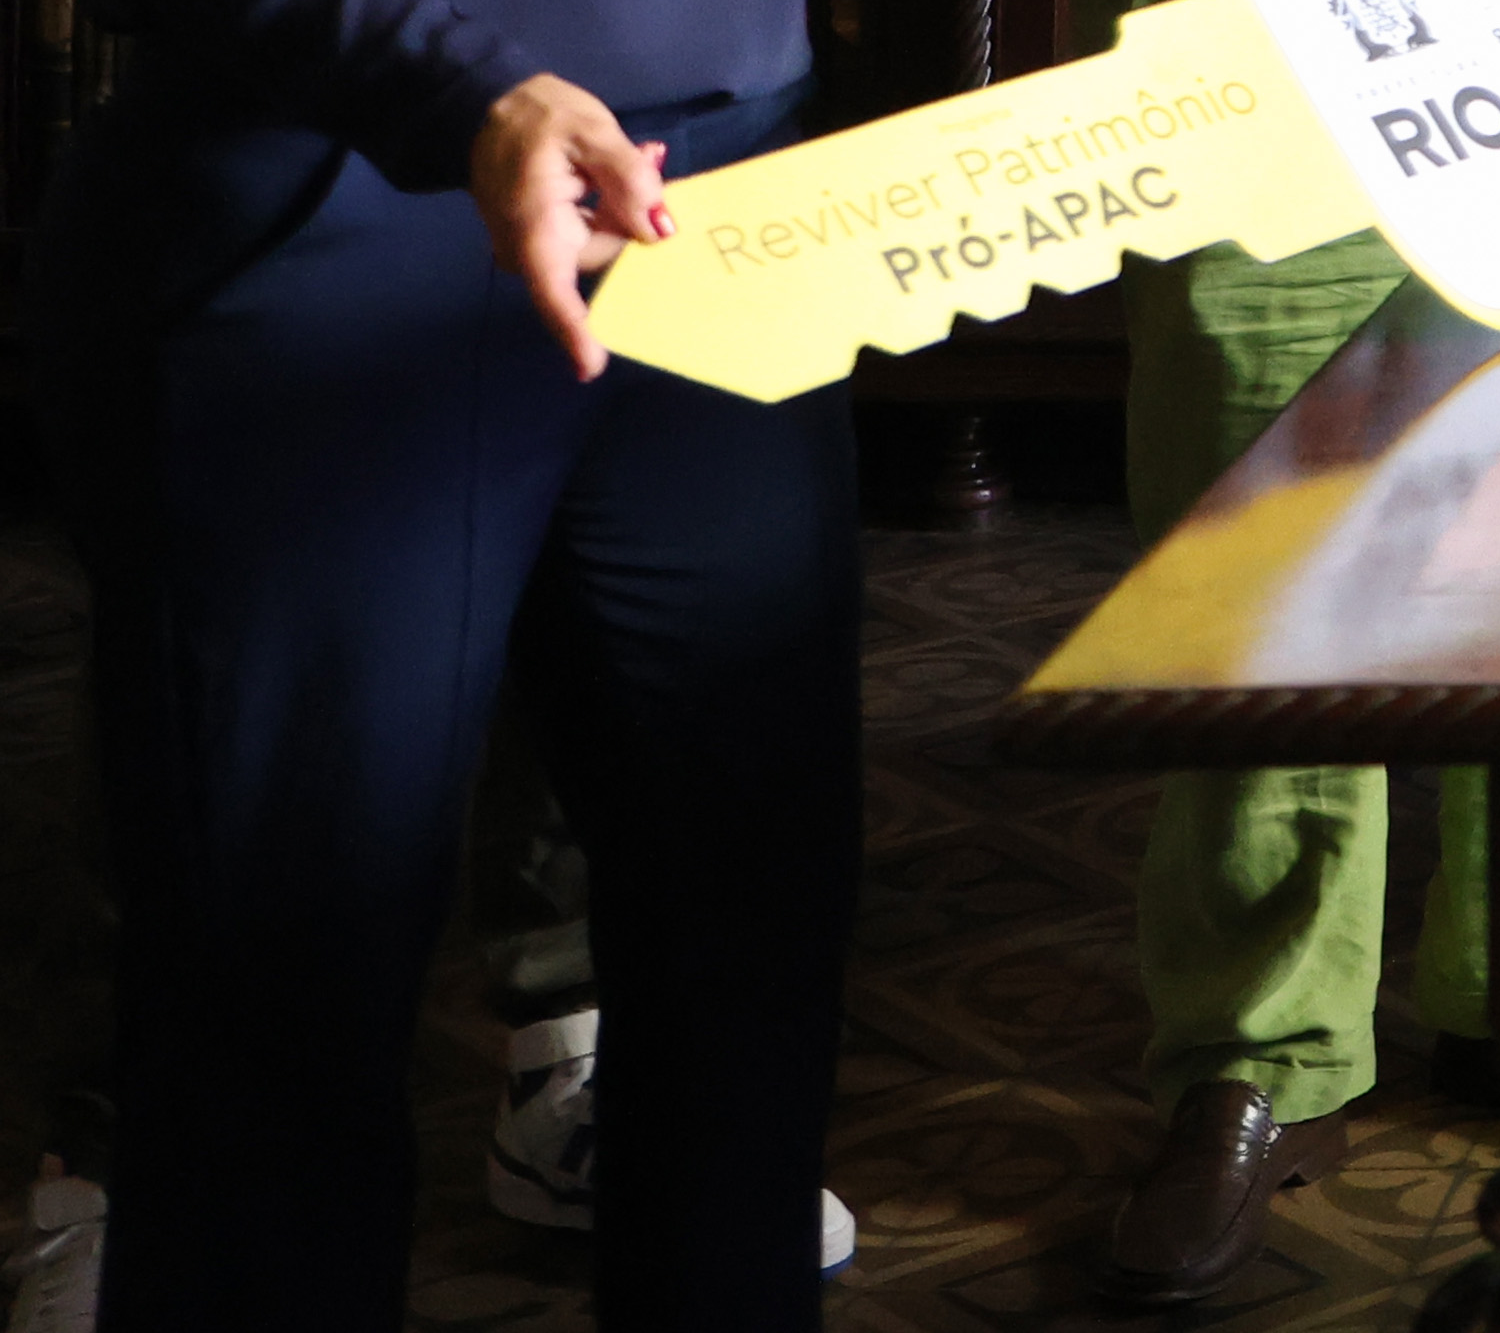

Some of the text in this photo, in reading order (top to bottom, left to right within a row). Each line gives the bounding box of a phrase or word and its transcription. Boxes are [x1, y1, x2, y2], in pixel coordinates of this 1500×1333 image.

[707, 77, 1257, 274] Reviver Patrimônio
[881, 166, 1178, 293] Pró-APAC
